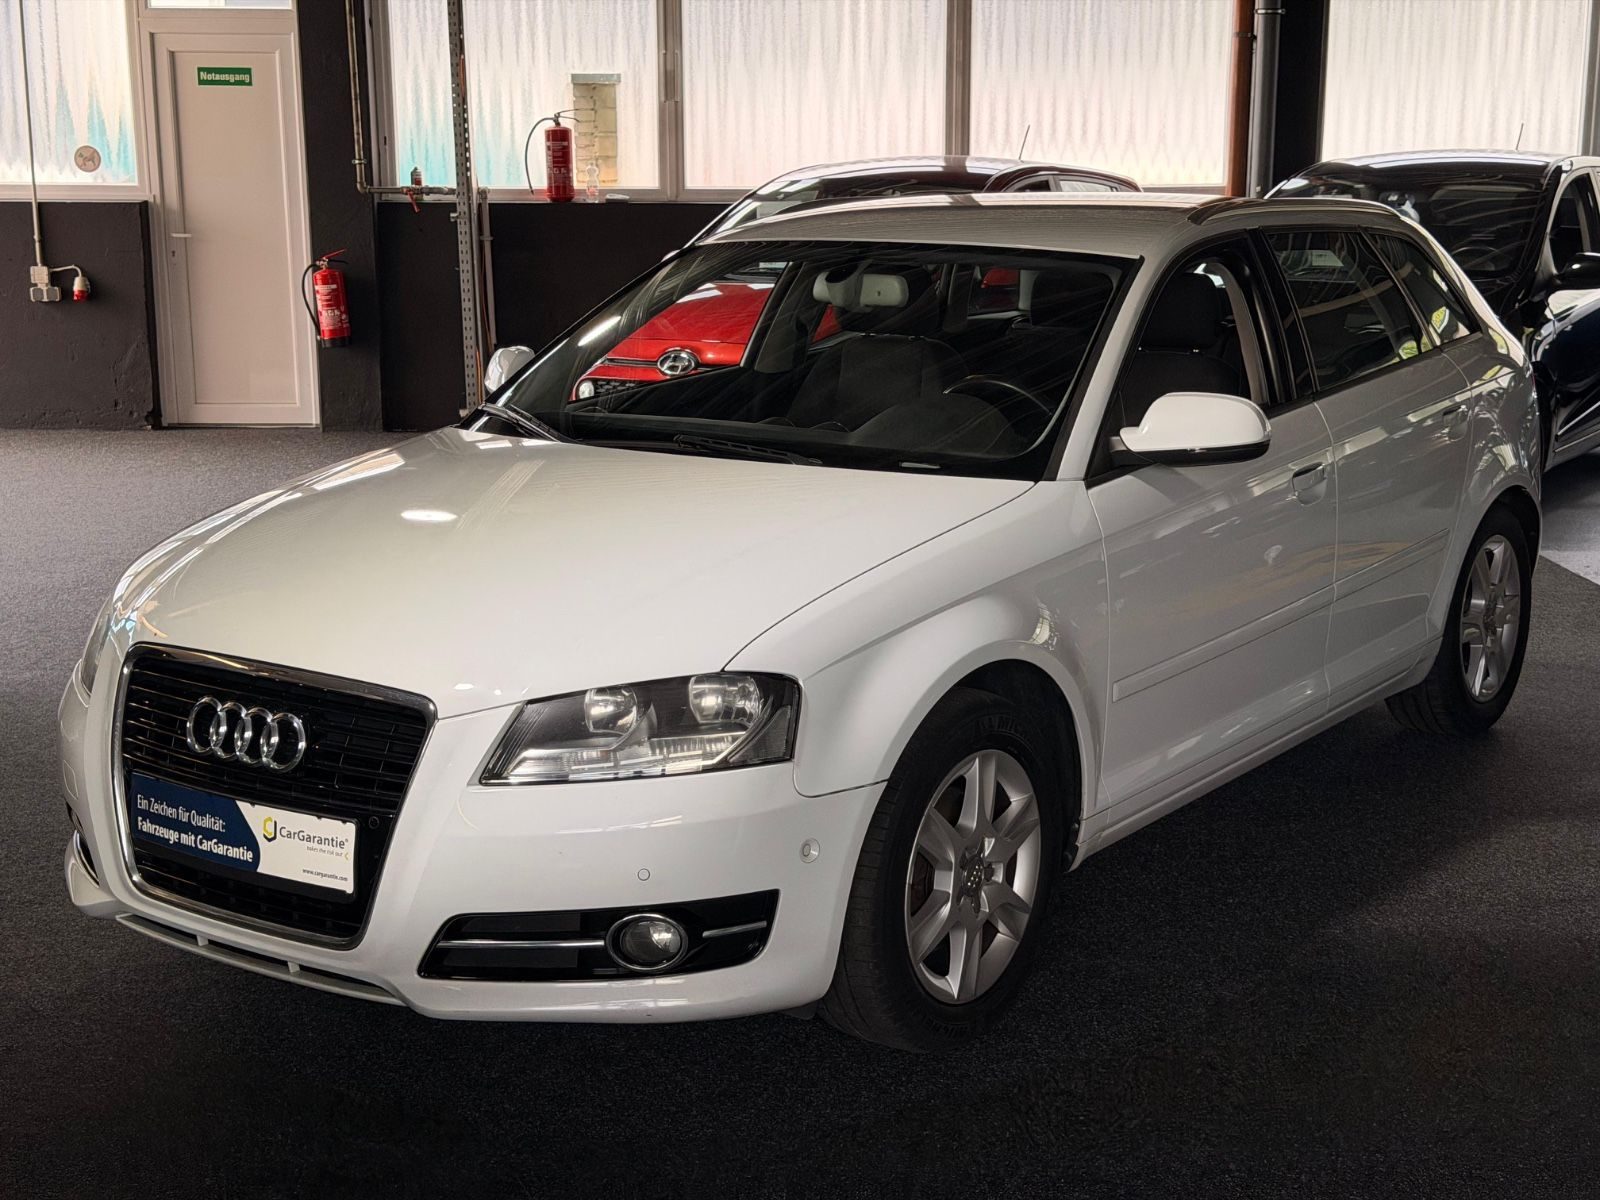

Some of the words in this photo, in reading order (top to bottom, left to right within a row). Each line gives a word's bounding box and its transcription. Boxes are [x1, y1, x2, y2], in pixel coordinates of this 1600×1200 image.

[200, 72, 250, 83] Notausgang
[137, 794, 149, 809] Ein
[150, 798, 177, 819] Zeichen
[178, 806, 190, 822] für
[191, 810, 226, 833] Qualität:
[138, 817, 179, 844] Fahrzeuge
[180, 831, 195, 848] mit
[197, 834, 254, 863] CarGarantie
